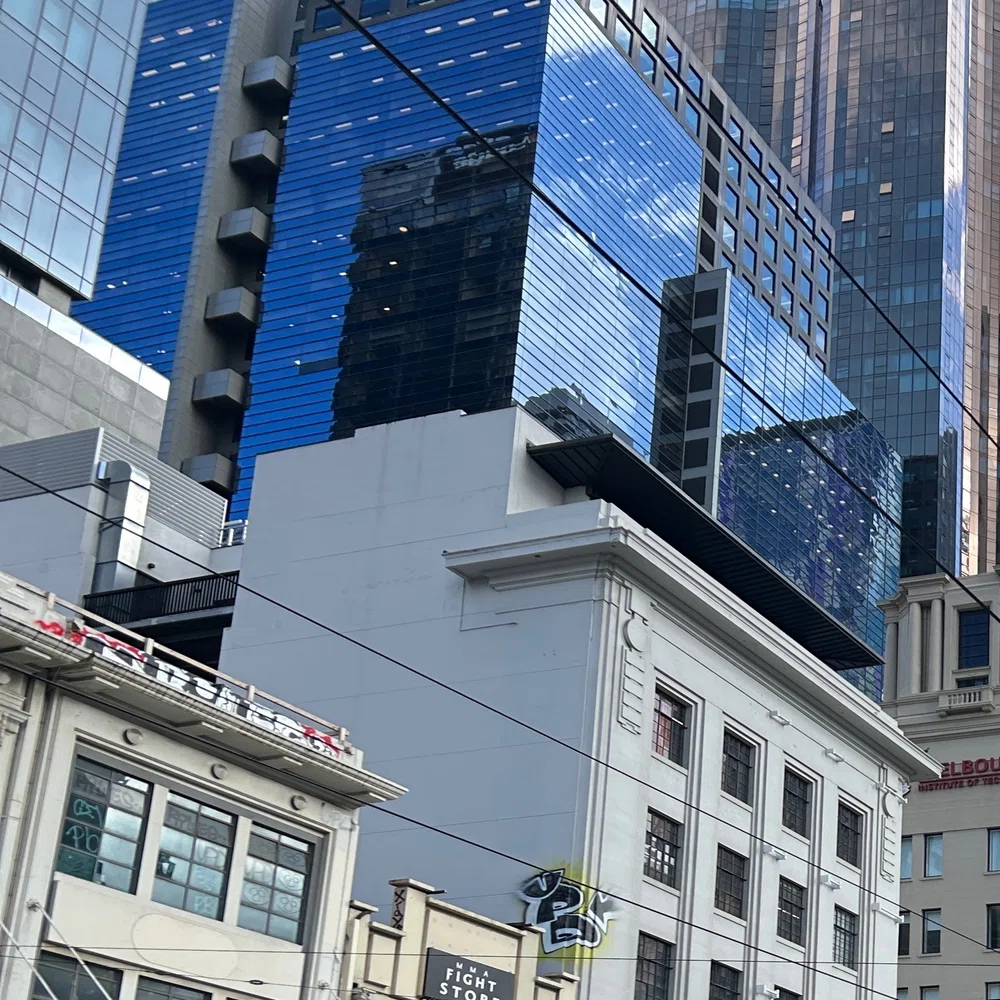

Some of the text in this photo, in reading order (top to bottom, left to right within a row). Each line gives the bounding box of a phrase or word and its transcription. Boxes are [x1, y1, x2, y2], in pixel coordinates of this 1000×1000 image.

[918, 782, 963, 792] INSTITUTE
[967, 779, 979, 787] OF
[456, 962, 488, 977] MMA
[446, 968, 497, 992] FIGHT
